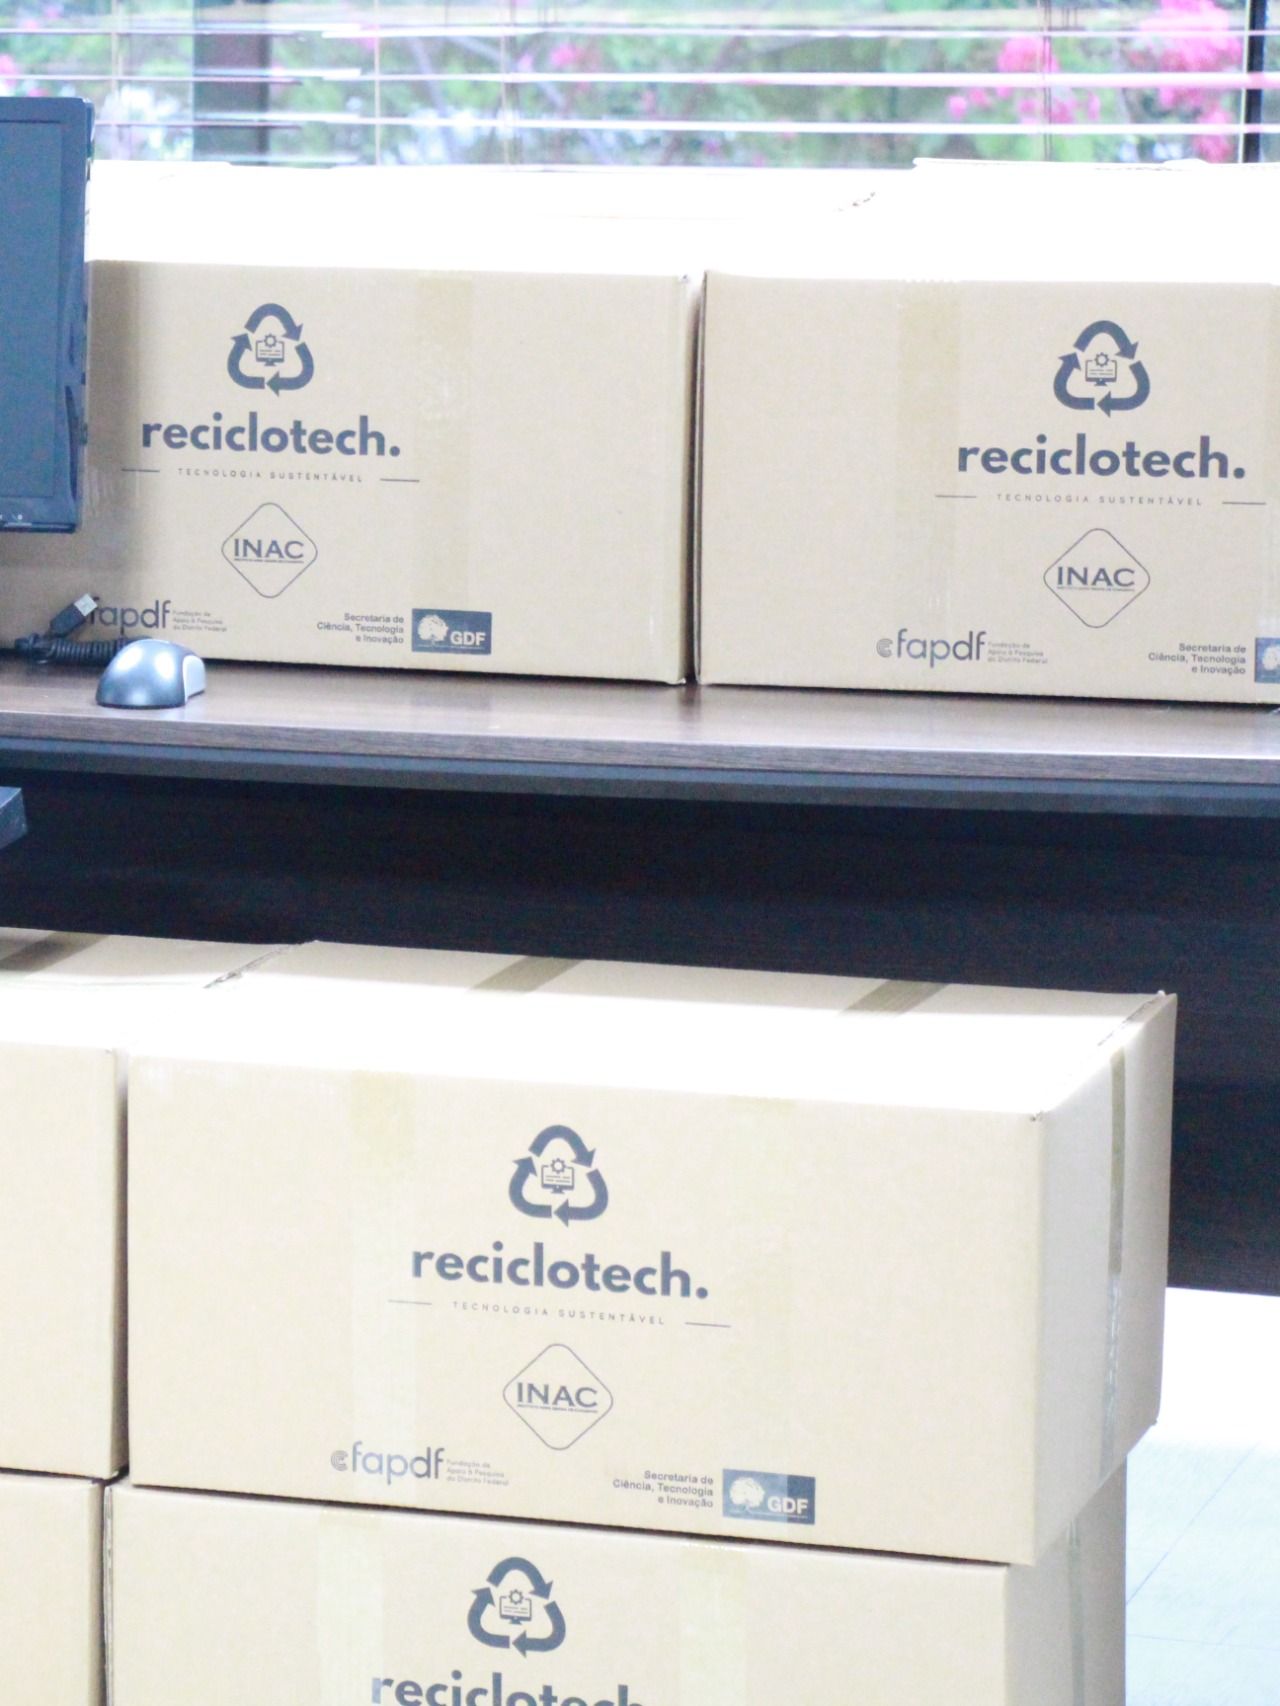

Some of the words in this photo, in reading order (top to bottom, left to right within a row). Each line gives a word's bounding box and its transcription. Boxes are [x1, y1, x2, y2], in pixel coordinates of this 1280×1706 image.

[141, 411, 400, 458] reciclotech.
[958, 433, 1245, 479] reciclotech.
[177, 467, 262, 479] TECNOLOGIA
[269, 471, 363, 483] SUSTENTÁVEL
[996, 493, 1089, 504] TECNOLOGIA
[1098, 495, 1202, 507] SUSTENTÁVEL
[233, 537, 304, 560] INAC
[1057, 566, 1135, 587] INAC
[343, 612, 391, 624] Secretaria
[392, 615, 405, 624] de
[316, 621, 353, 633] Ciência,
[354, 622, 405, 636] Tecnologia
[449, 630, 486, 646] GDF
[363, 634, 405, 646] Inovação
[898, 628, 986, 668] fapdf
[1178, 642, 1232, 653] Secretaria
[1233, 644, 1247, 654] de
[1147, 651, 1189, 664] Ciência,
[1191, 653, 1247, 667] Tecnologia
[1200, 663, 1247, 677] Inovação
[413, 1241, 708, 1299] reciclotech.
[452, 1300, 549, 1316] TECNOLOGIA
[558, 1308, 665, 1326] SUSTENTÁVEL
[517, 1382, 598, 1408] INAC
[352, 1441, 445, 1485] fapdf
[643, 1469, 699, 1484] Secretaria
[700, 1475, 714, 1486] de
[612, 1478, 655, 1493] Ciência,
[657, 1482, 714, 1499] Tecnologia
[666, 1495, 714, 1509] Inovação
[766, 1494, 809, 1515] GDF
